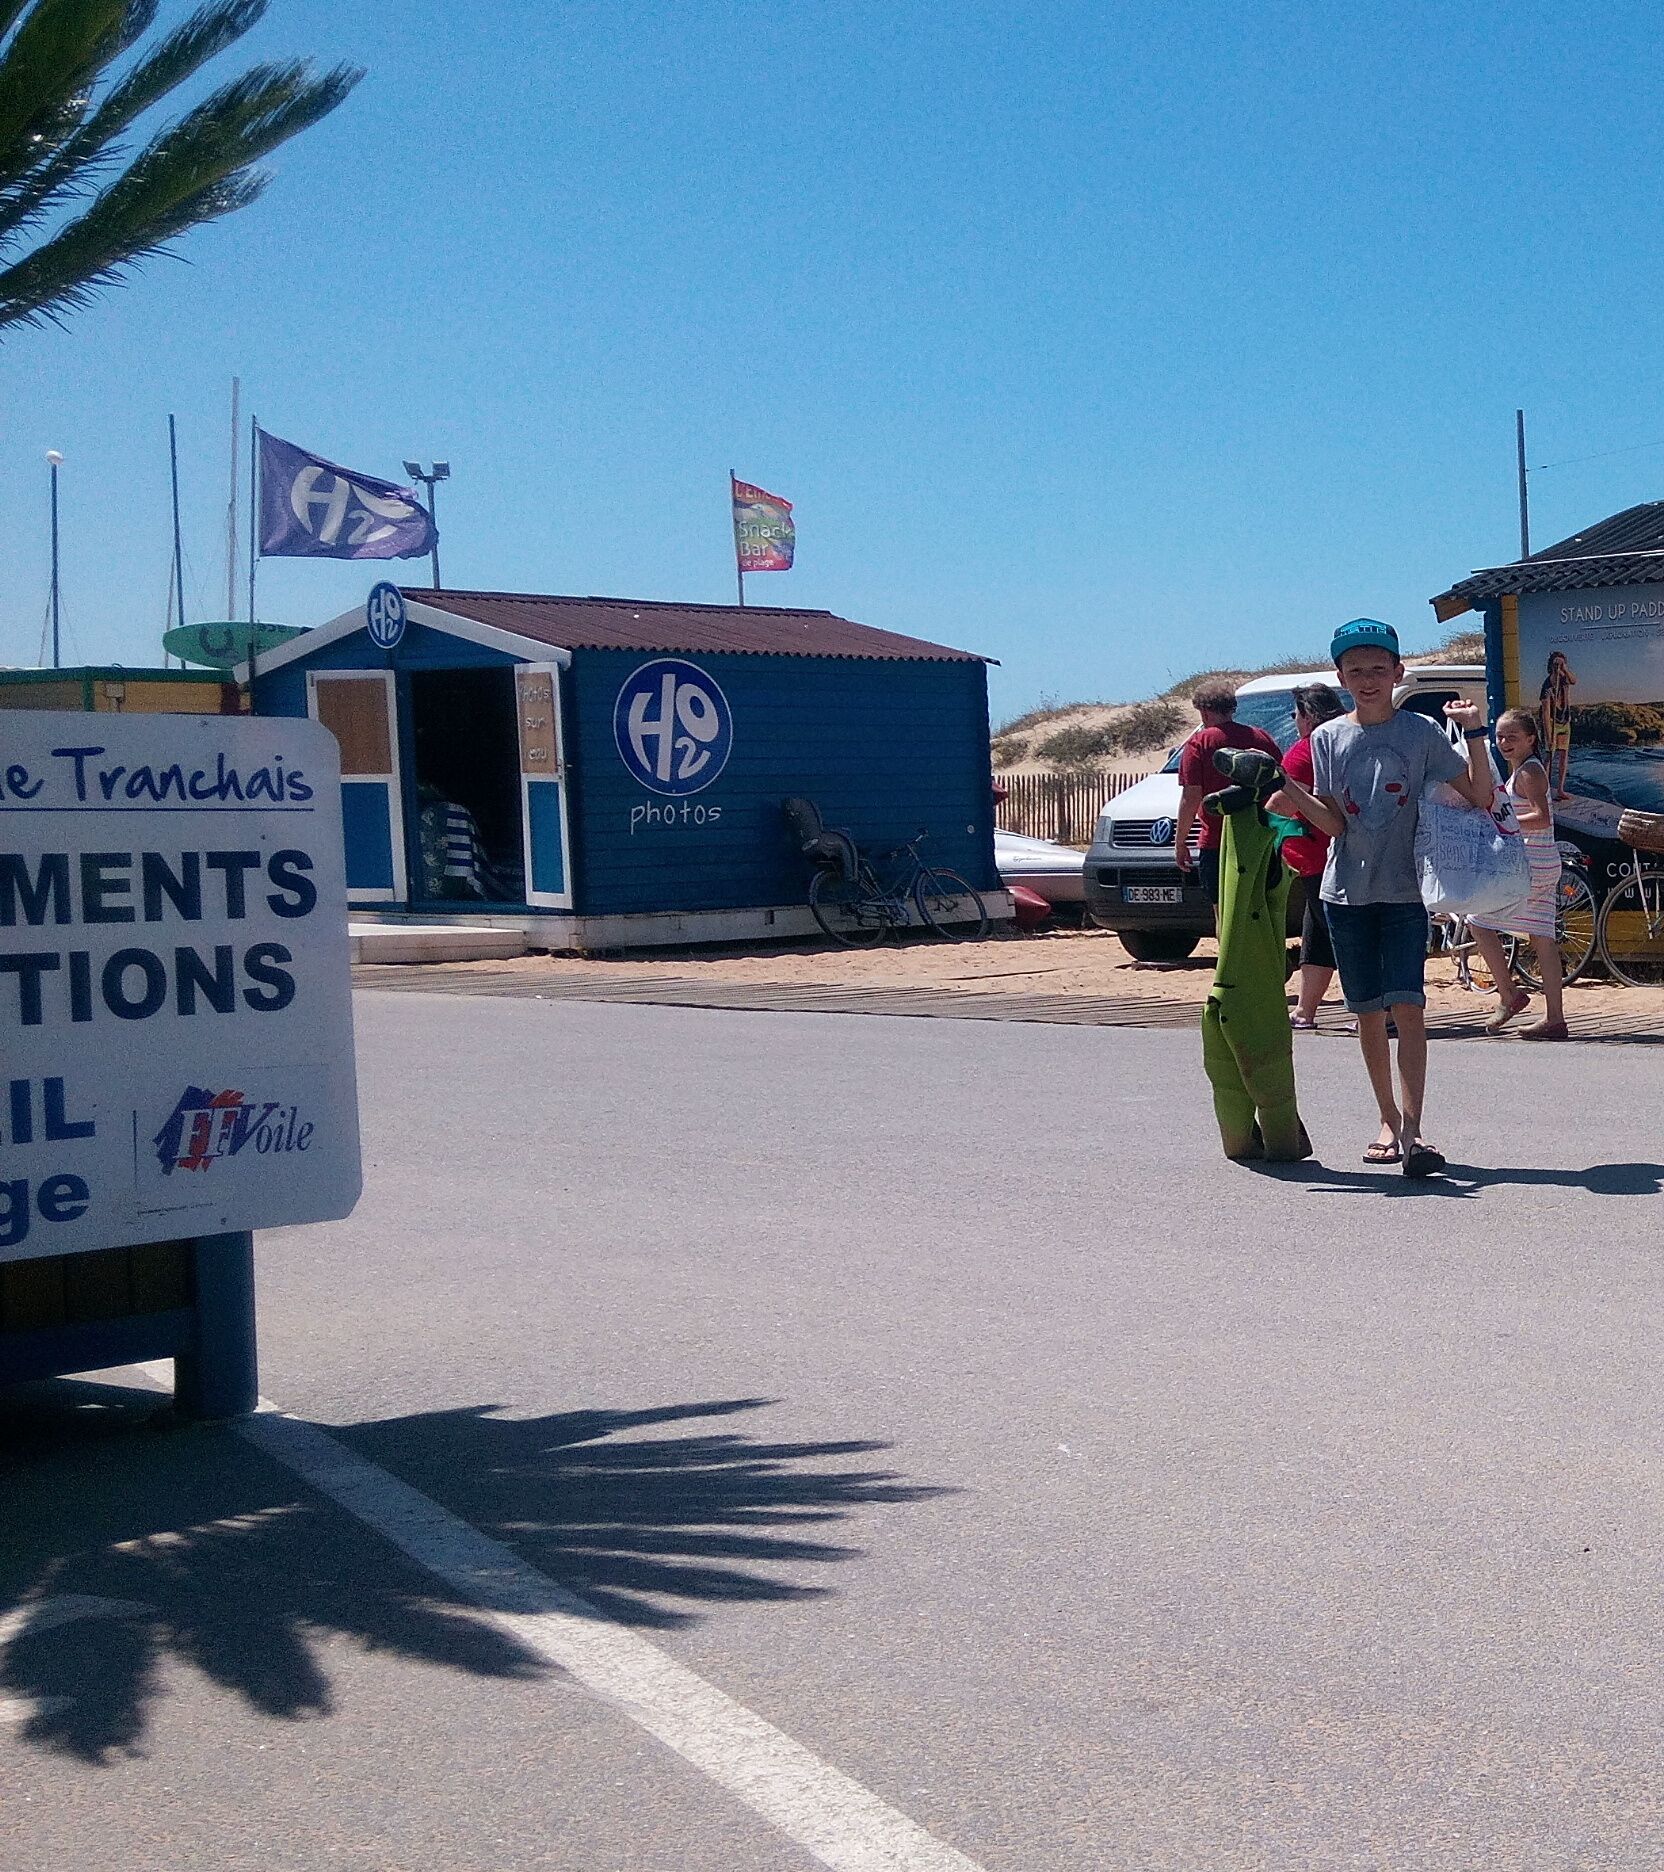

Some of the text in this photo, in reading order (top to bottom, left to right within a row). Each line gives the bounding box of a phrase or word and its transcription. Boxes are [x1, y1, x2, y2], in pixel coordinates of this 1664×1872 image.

[739, 521, 791, 538] Snack
[741, 541, 767, 557] Bar
[1560, 605, 1603, 623] STAND
[1608, 603, 1626, 620] UP
[51, 747, 314, 802] Tranchais
[630, 800, 722, 836] photos
[0, 849, 318, 926] MENTS
[0, 942, 296, 1025] TIONS
[0, 1077, 96, 1144] IL
